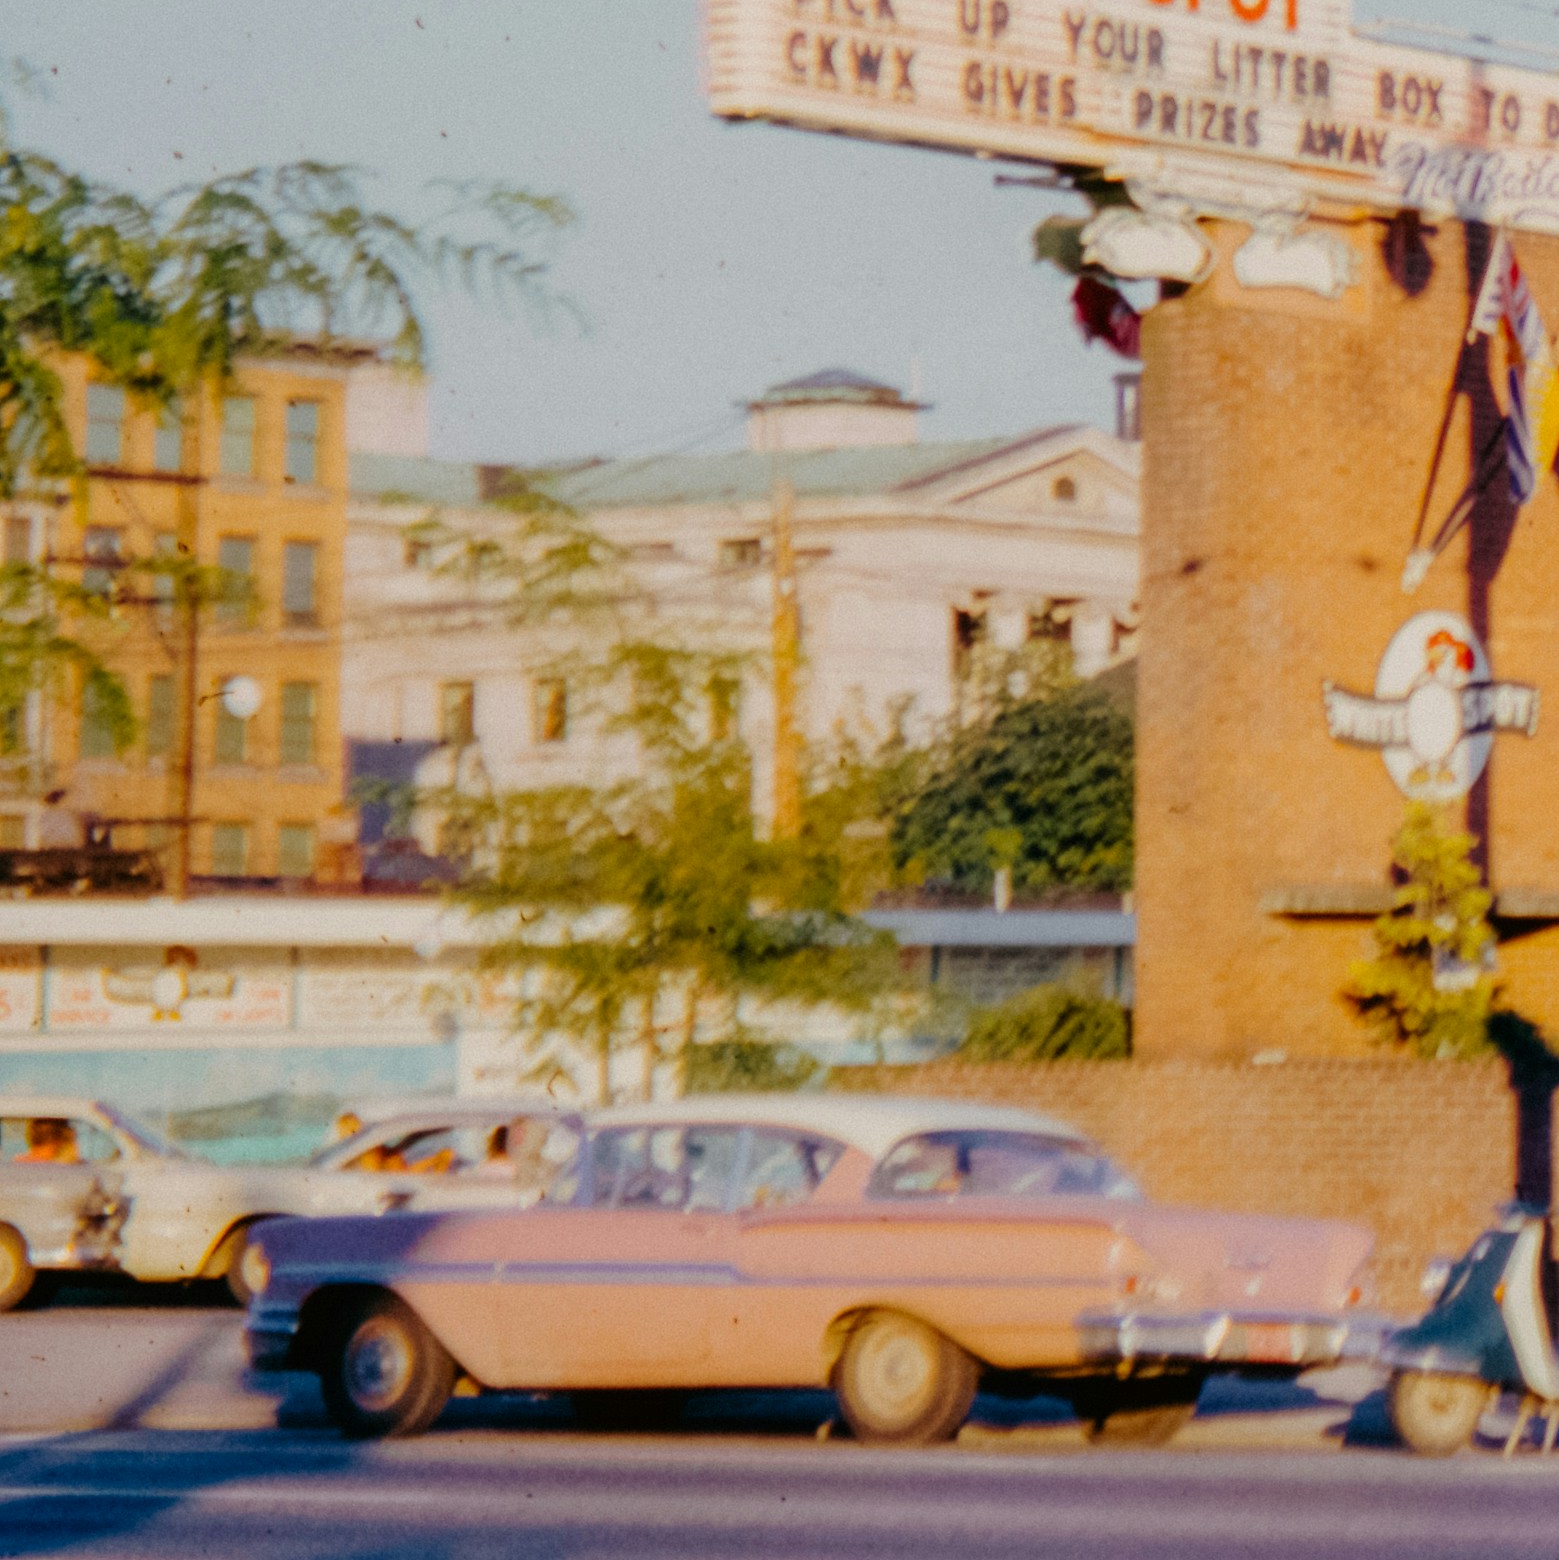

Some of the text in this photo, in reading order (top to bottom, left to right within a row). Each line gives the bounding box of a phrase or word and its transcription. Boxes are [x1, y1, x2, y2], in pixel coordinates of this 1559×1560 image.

[784, 31, 1388, 168] CKWX GIVES PRIZES AWAY
[1061, 8, 1165, 68] YOUR
[1210, 37, 1331, 100] LITTER
[1376, 70, 1444, 122] BOX
[1474, 86, 1521, 133] TO
